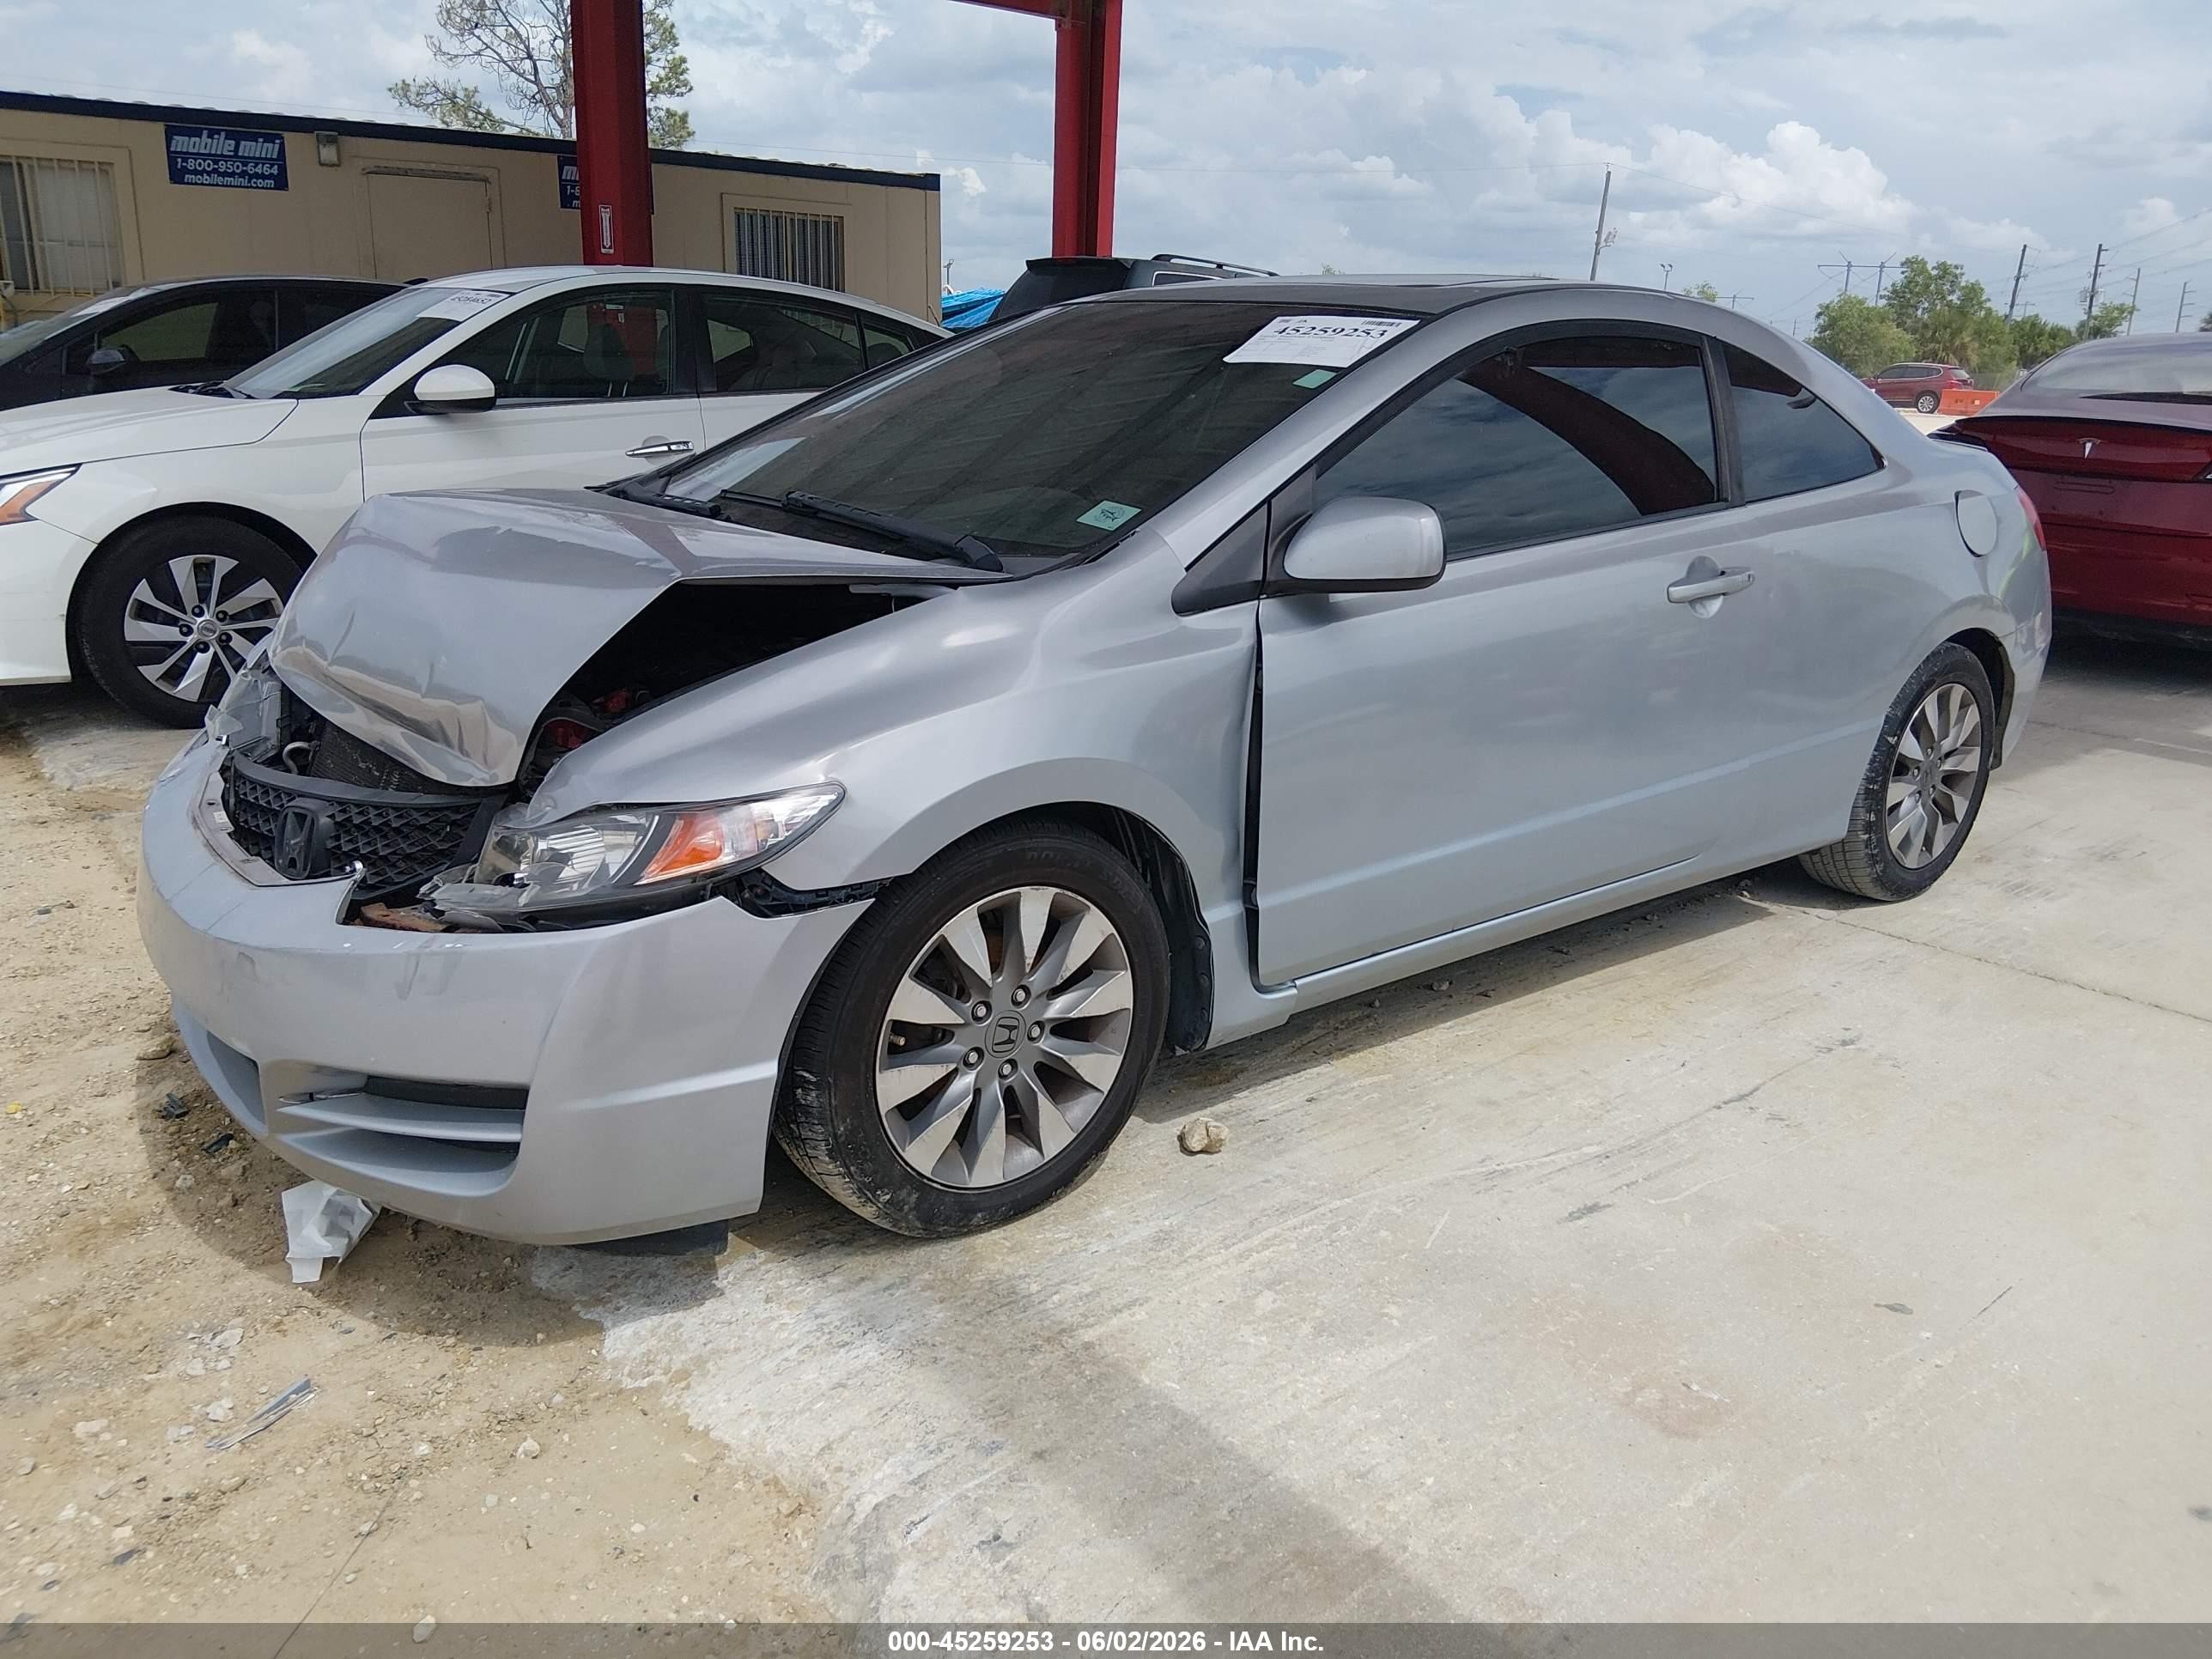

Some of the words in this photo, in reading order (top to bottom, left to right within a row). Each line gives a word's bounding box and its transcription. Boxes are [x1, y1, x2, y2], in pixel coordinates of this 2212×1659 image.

[170, 131, 235, 155] mobile
[238, 137, 281, 159] mini
[176, 158, 278, 175] 1-800-950-6464
[184, 173, 275, 188] mobilemini.com
[1273, 325, 1389, 339] 45259253
